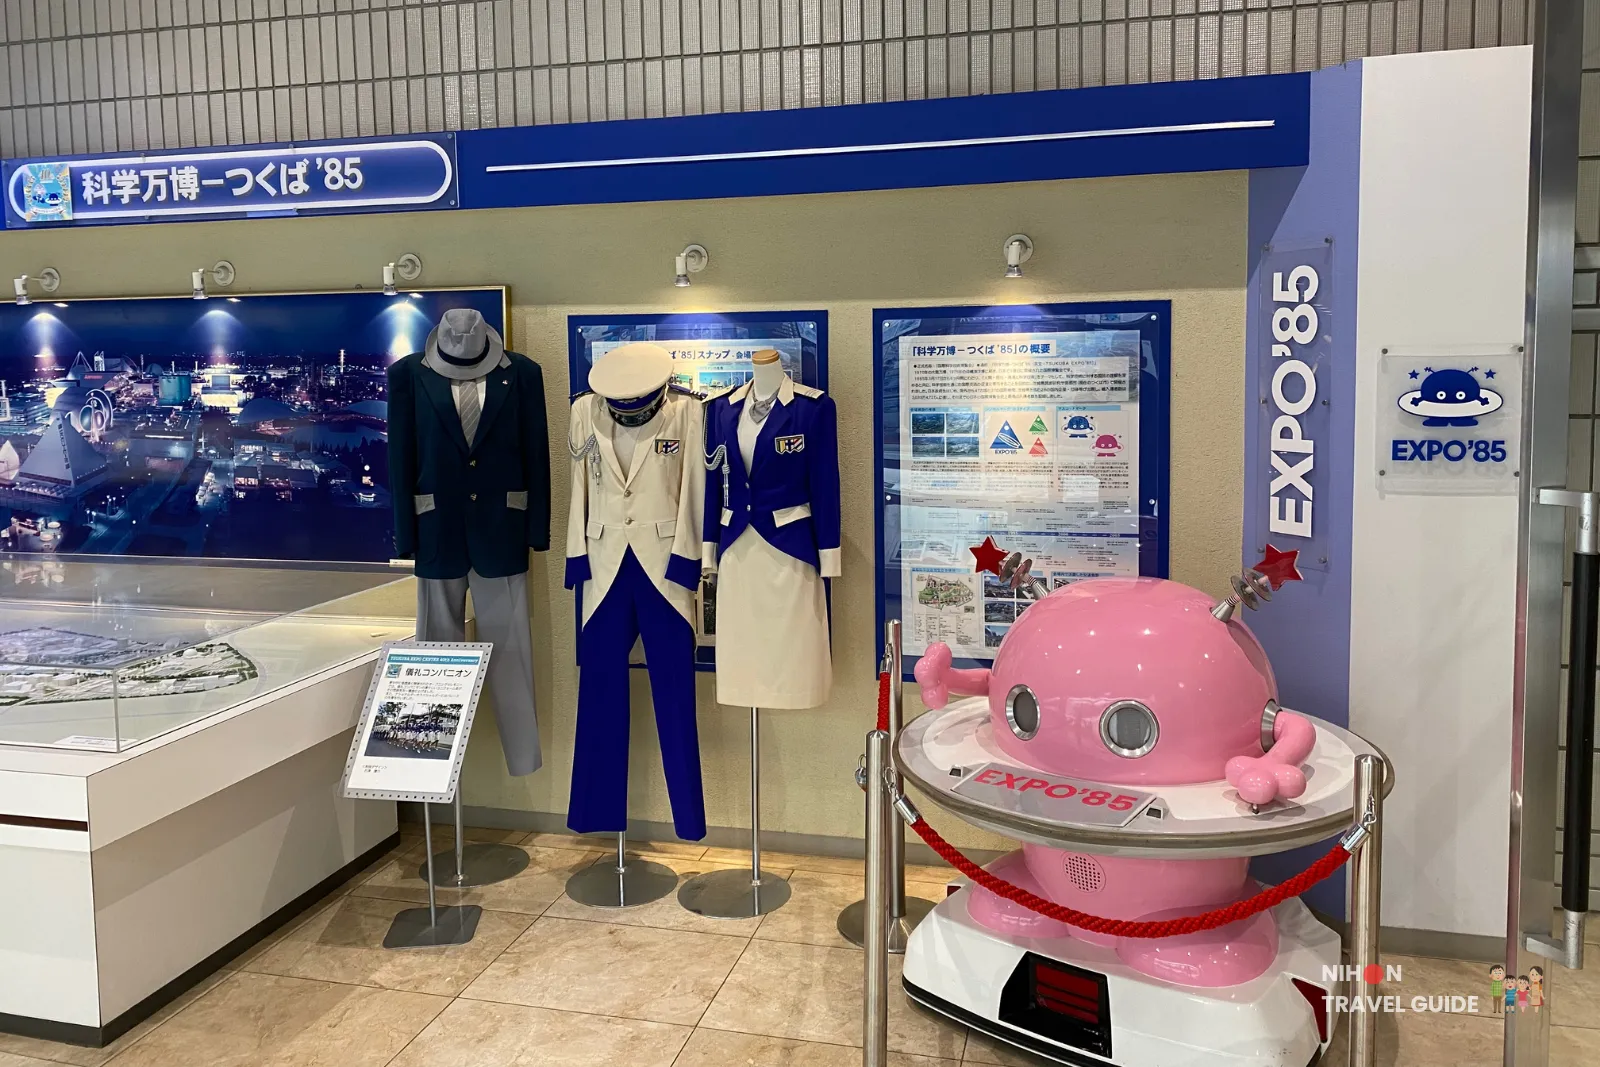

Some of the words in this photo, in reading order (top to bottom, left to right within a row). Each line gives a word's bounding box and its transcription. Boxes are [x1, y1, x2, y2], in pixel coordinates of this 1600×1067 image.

[1270, 265, 1318, 538] EXPO'85
[1391, 439, 1507, 463] EXPO'85
[973, 769, 1139, 811] EXPO'85
